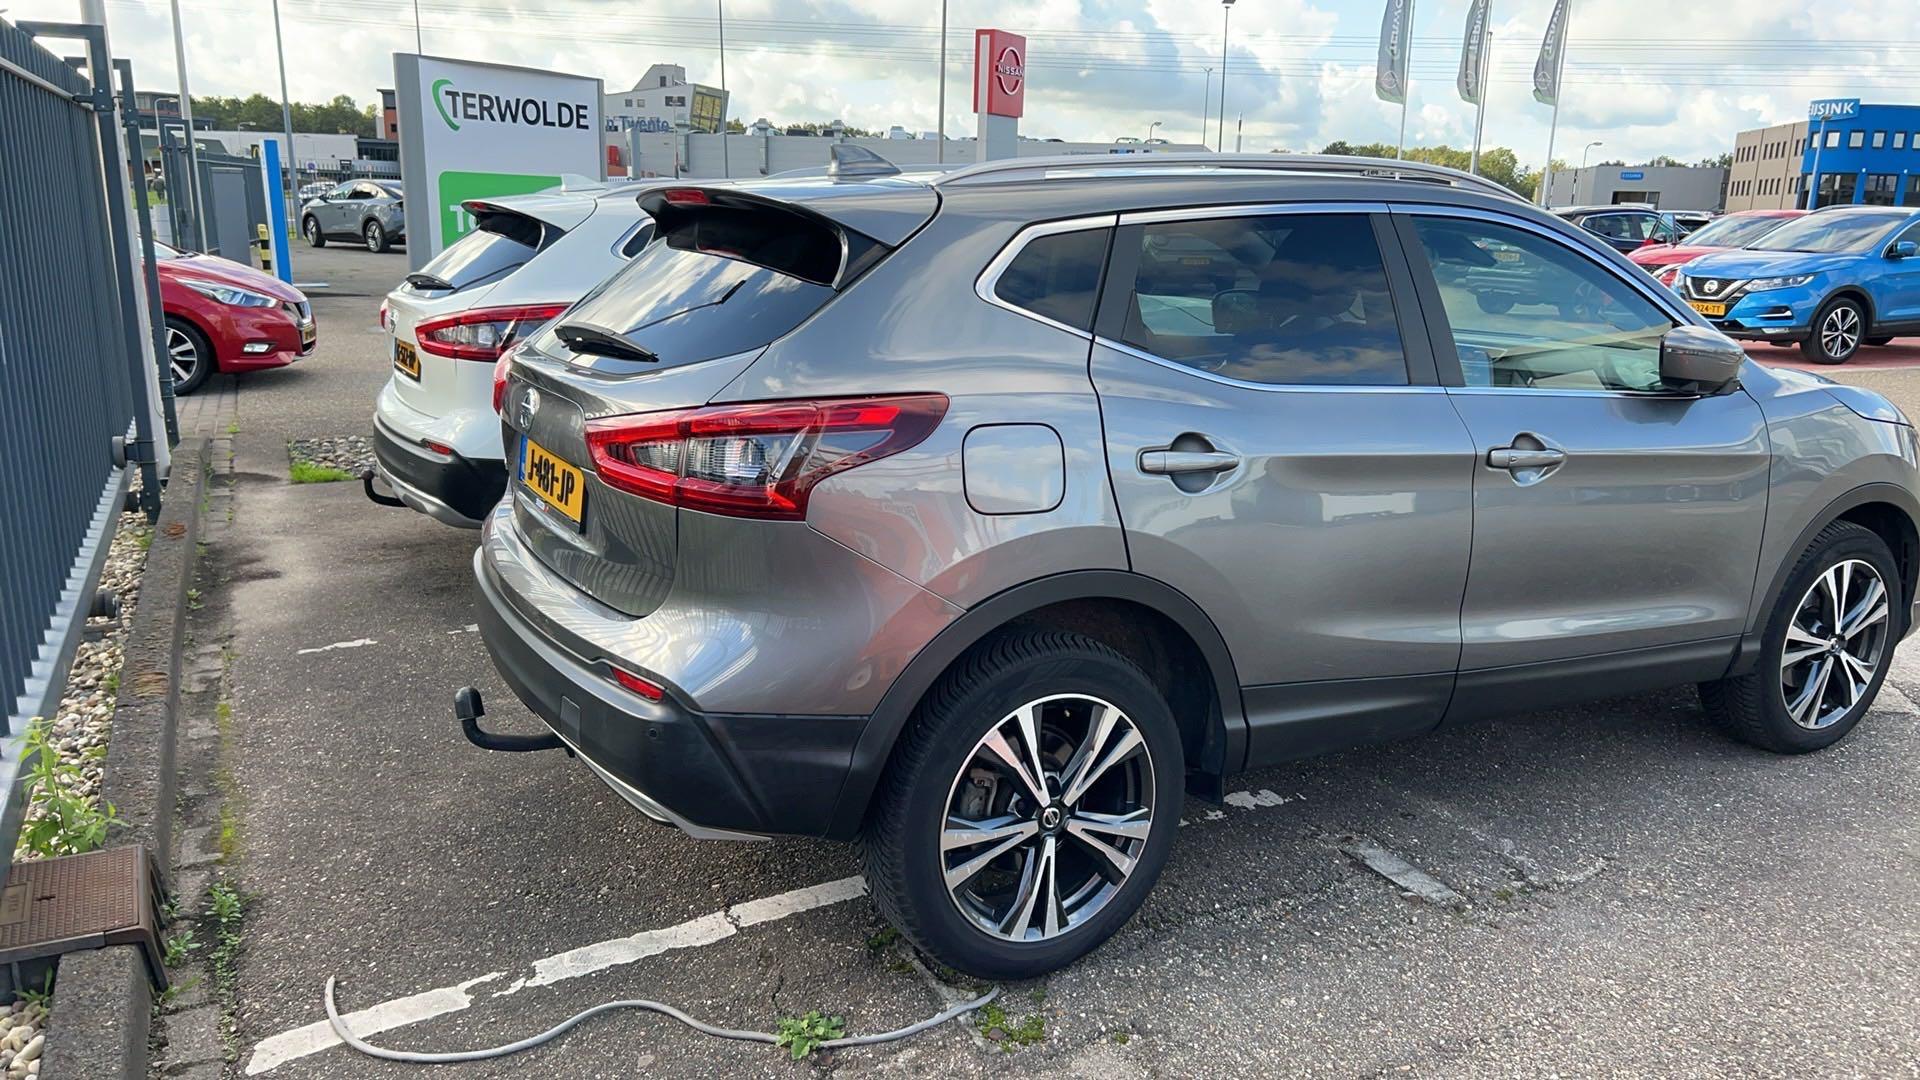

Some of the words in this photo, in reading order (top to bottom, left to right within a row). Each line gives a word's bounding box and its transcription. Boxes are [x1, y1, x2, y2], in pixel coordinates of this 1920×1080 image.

[998, 64, 1024, 77] NISSAN
[445, 90, 589, 130] TERWOLDE
[1809, 101, 1855, 116] IJSINK
[618, 115, 669, 132] Twente
[527, 448, 575, 507] J-481-JP
